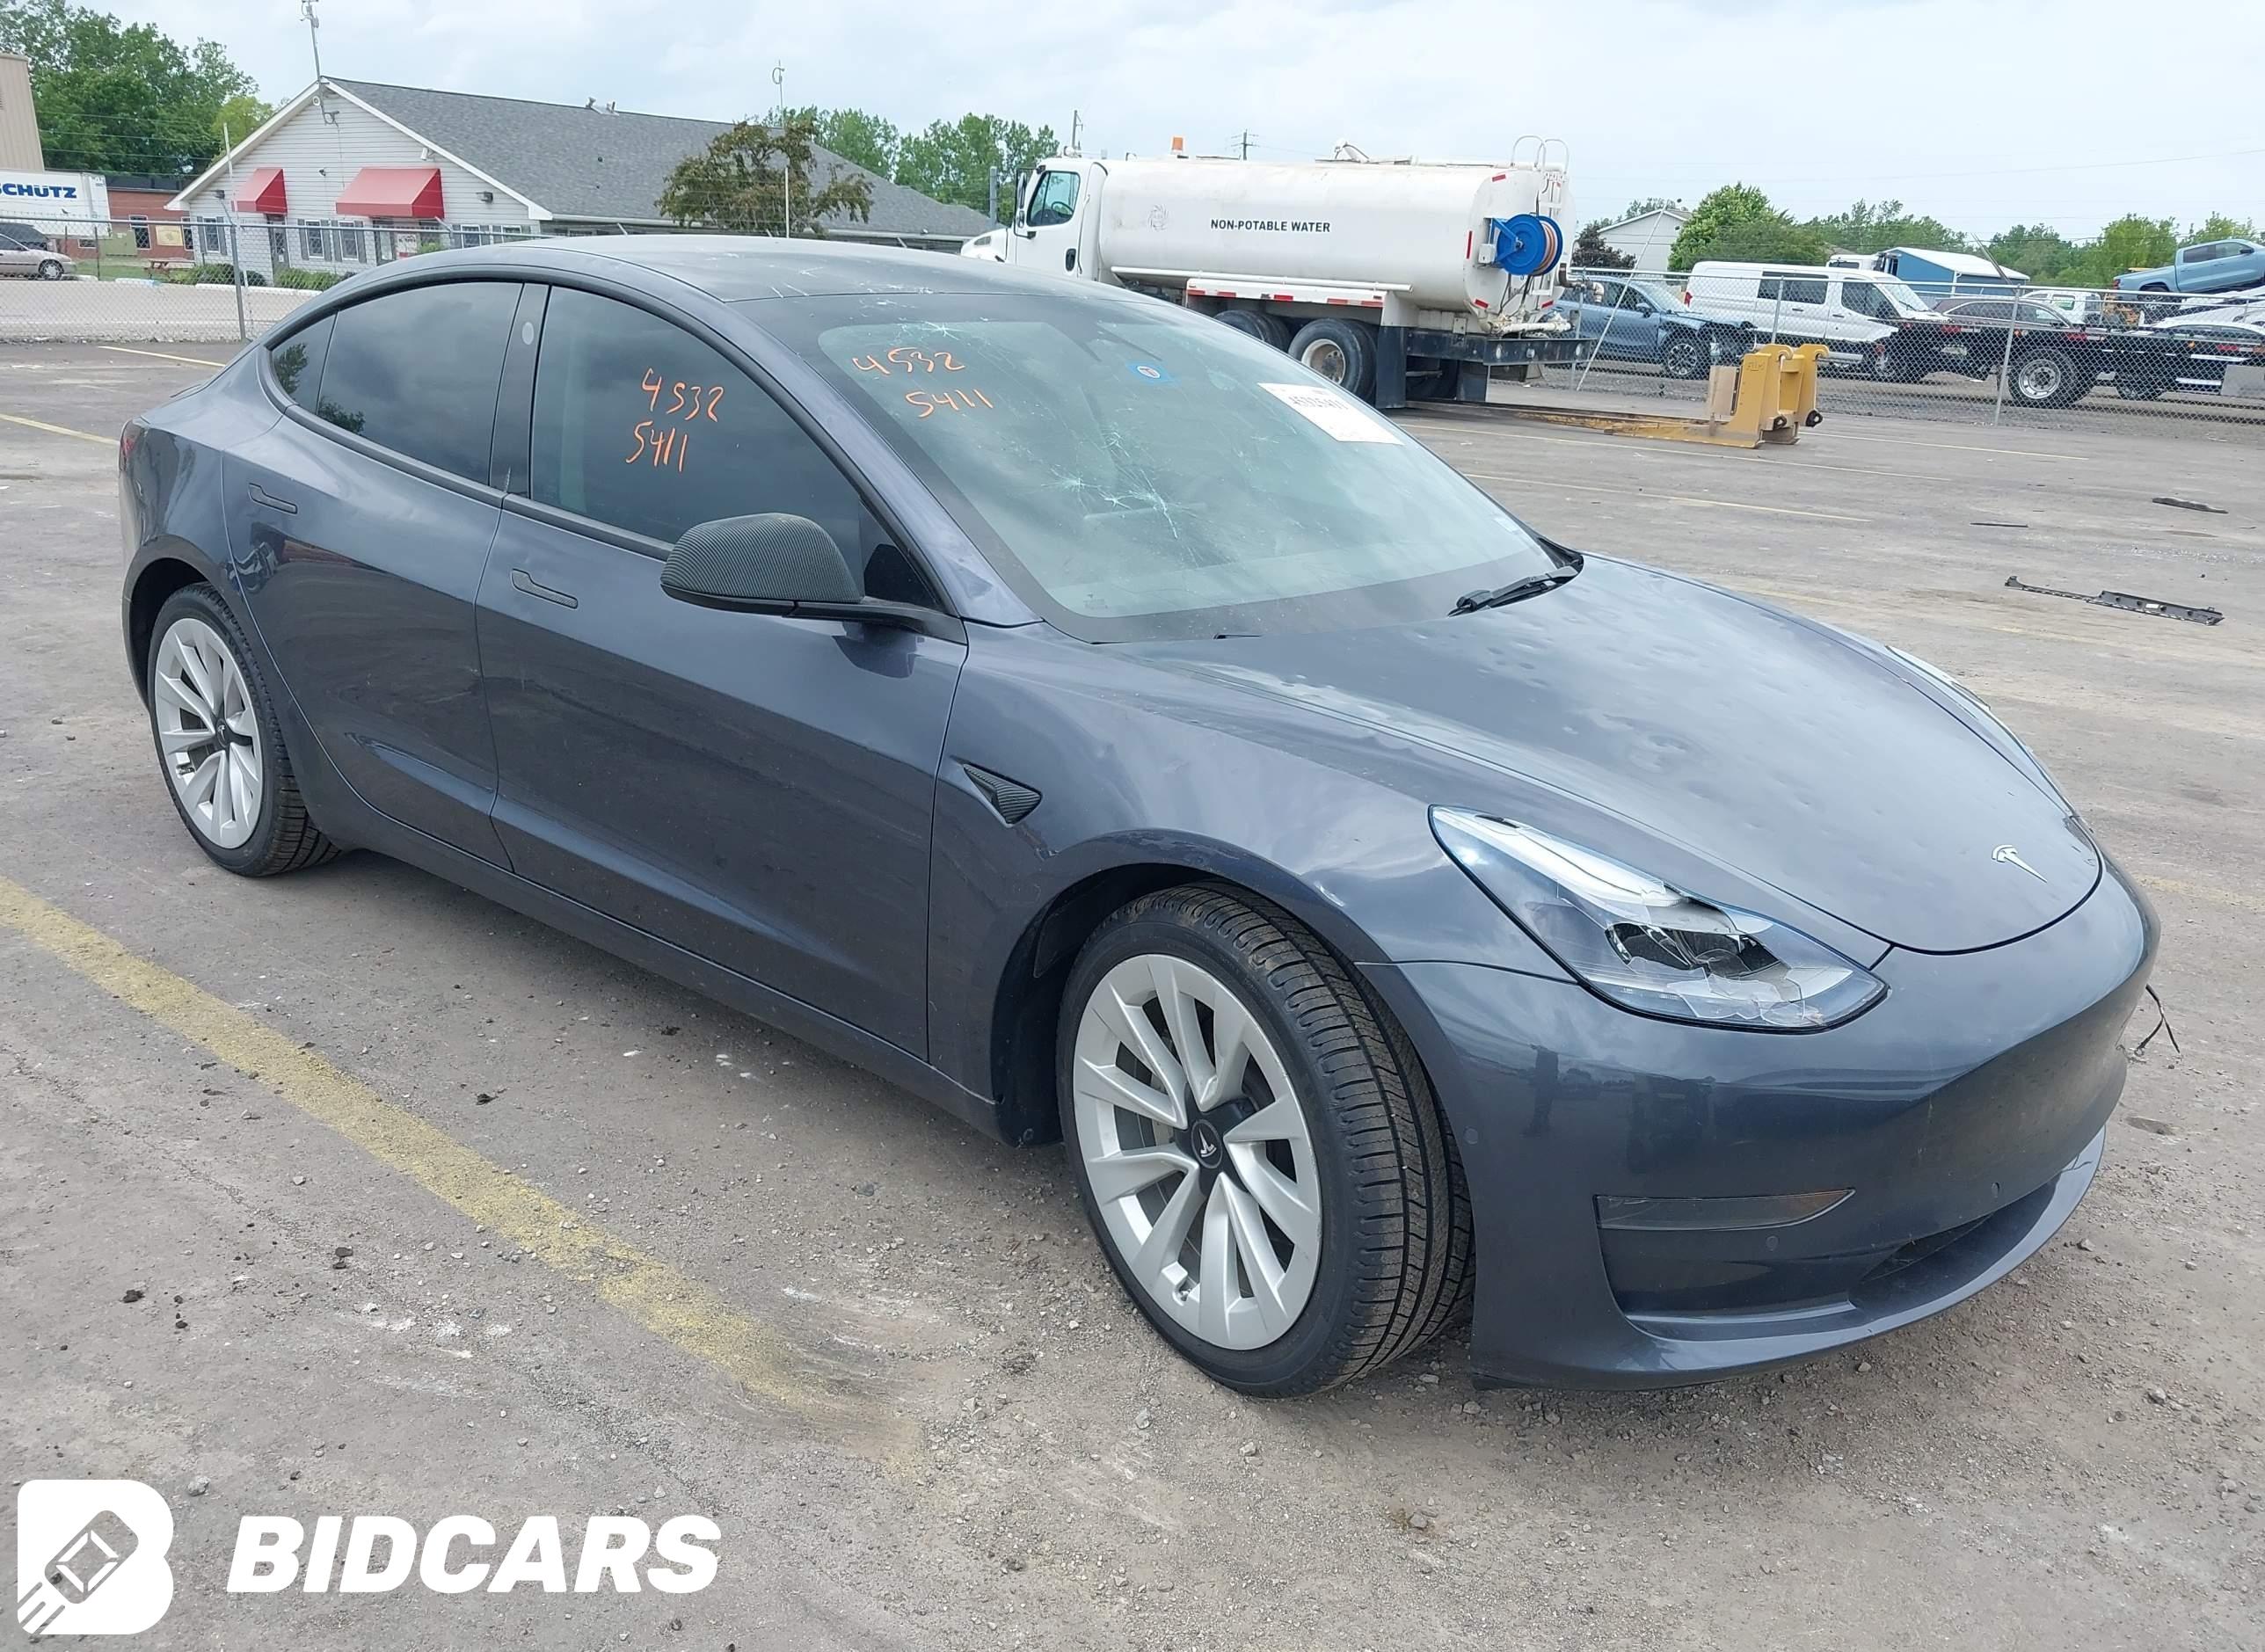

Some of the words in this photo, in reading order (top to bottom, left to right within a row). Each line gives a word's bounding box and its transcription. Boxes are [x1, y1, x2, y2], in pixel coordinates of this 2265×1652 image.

[0, 183, 77, 199] CHÜTZ
[1211, 219, 1288, 231] NON-POTABLE
[1292, 222, 1330, 233] WATER
[852, 346, 965, 375] 4532
[642, 368, 725, 422] 4532
[906, 389, 994, 418] 5411
[625, 420, 688, 472] 5411
